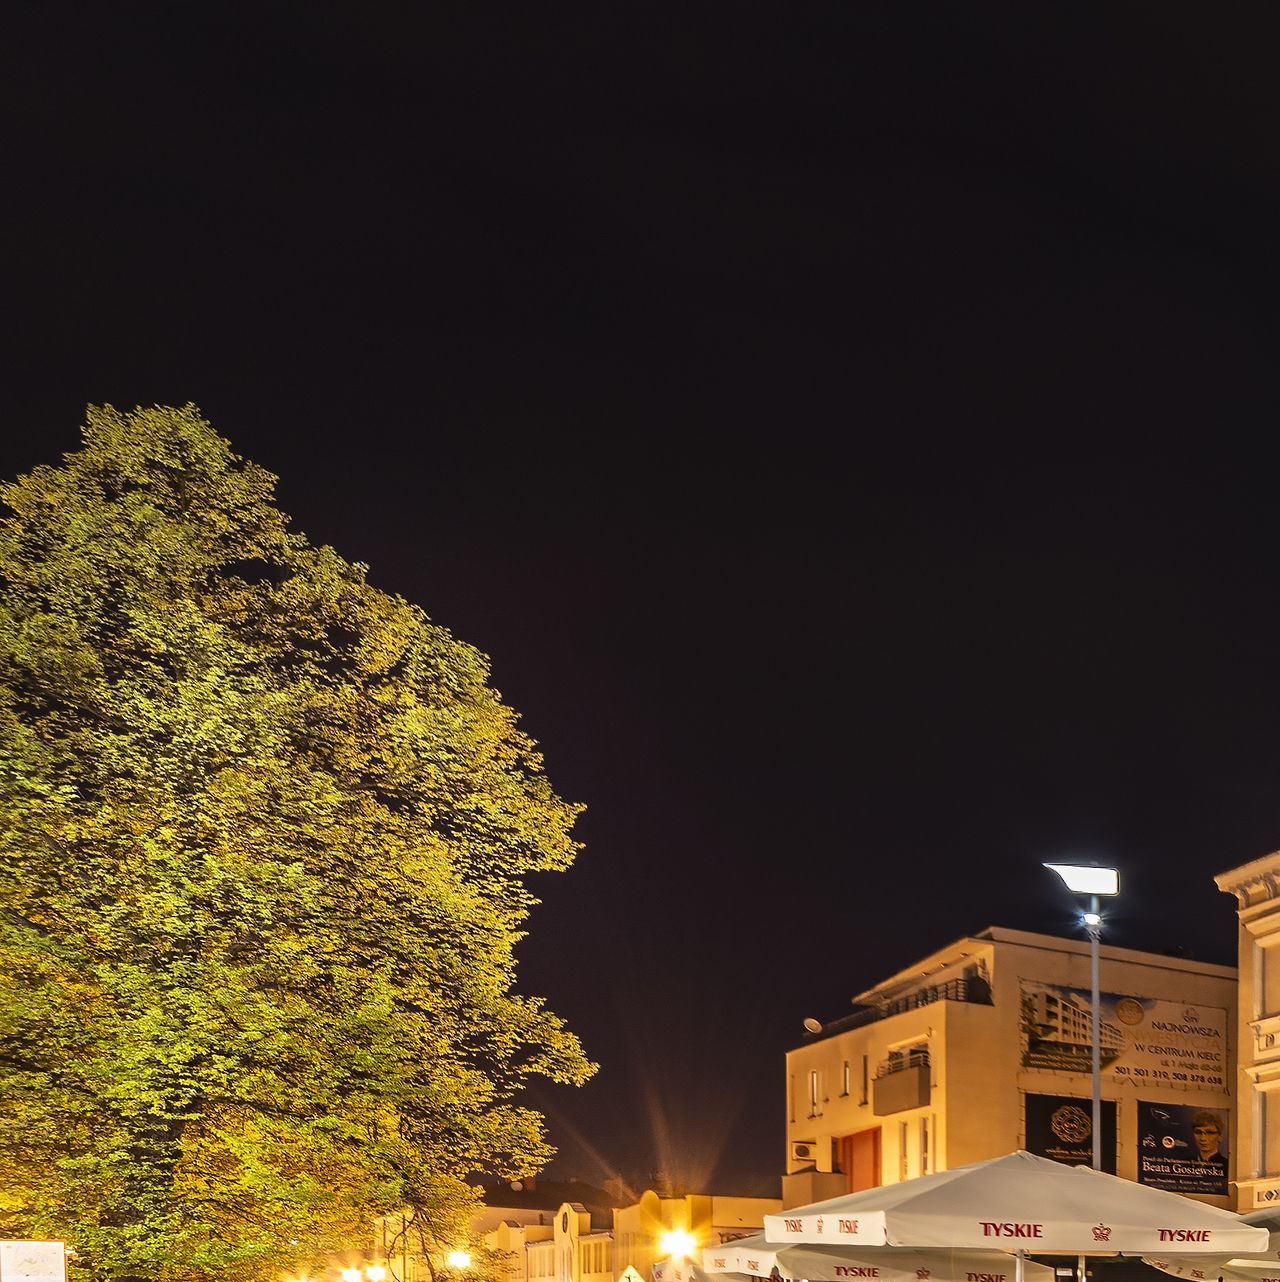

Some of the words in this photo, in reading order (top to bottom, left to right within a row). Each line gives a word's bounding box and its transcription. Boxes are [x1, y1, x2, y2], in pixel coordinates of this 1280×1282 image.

[1151, 1020, 1221, 1038] NAJNOWSZA
[1134, 1043, 1146, 1052] W
[1147, 1045, 1195, 1059] CENTRUM
[1196, 1050, 1221, 1062] KIELC
[1114, 1066, 1130, 1075] 501
[1134, 1067, 1149, 1077] 501
[1142, 1162, 1171, 1173] Beata
[1172, 1163, 1224, 1177] Gosiewska
[784, 1219, 803, 1233] TYSKIE
[839, 1219, 859, 1234] TYSKIE
[979, 1221, 1043, 1238] TYSKIE
[1157, 1229, 1212, 1242] TYSKIE
[834, 1266, 880, 1278] TYSKIE
